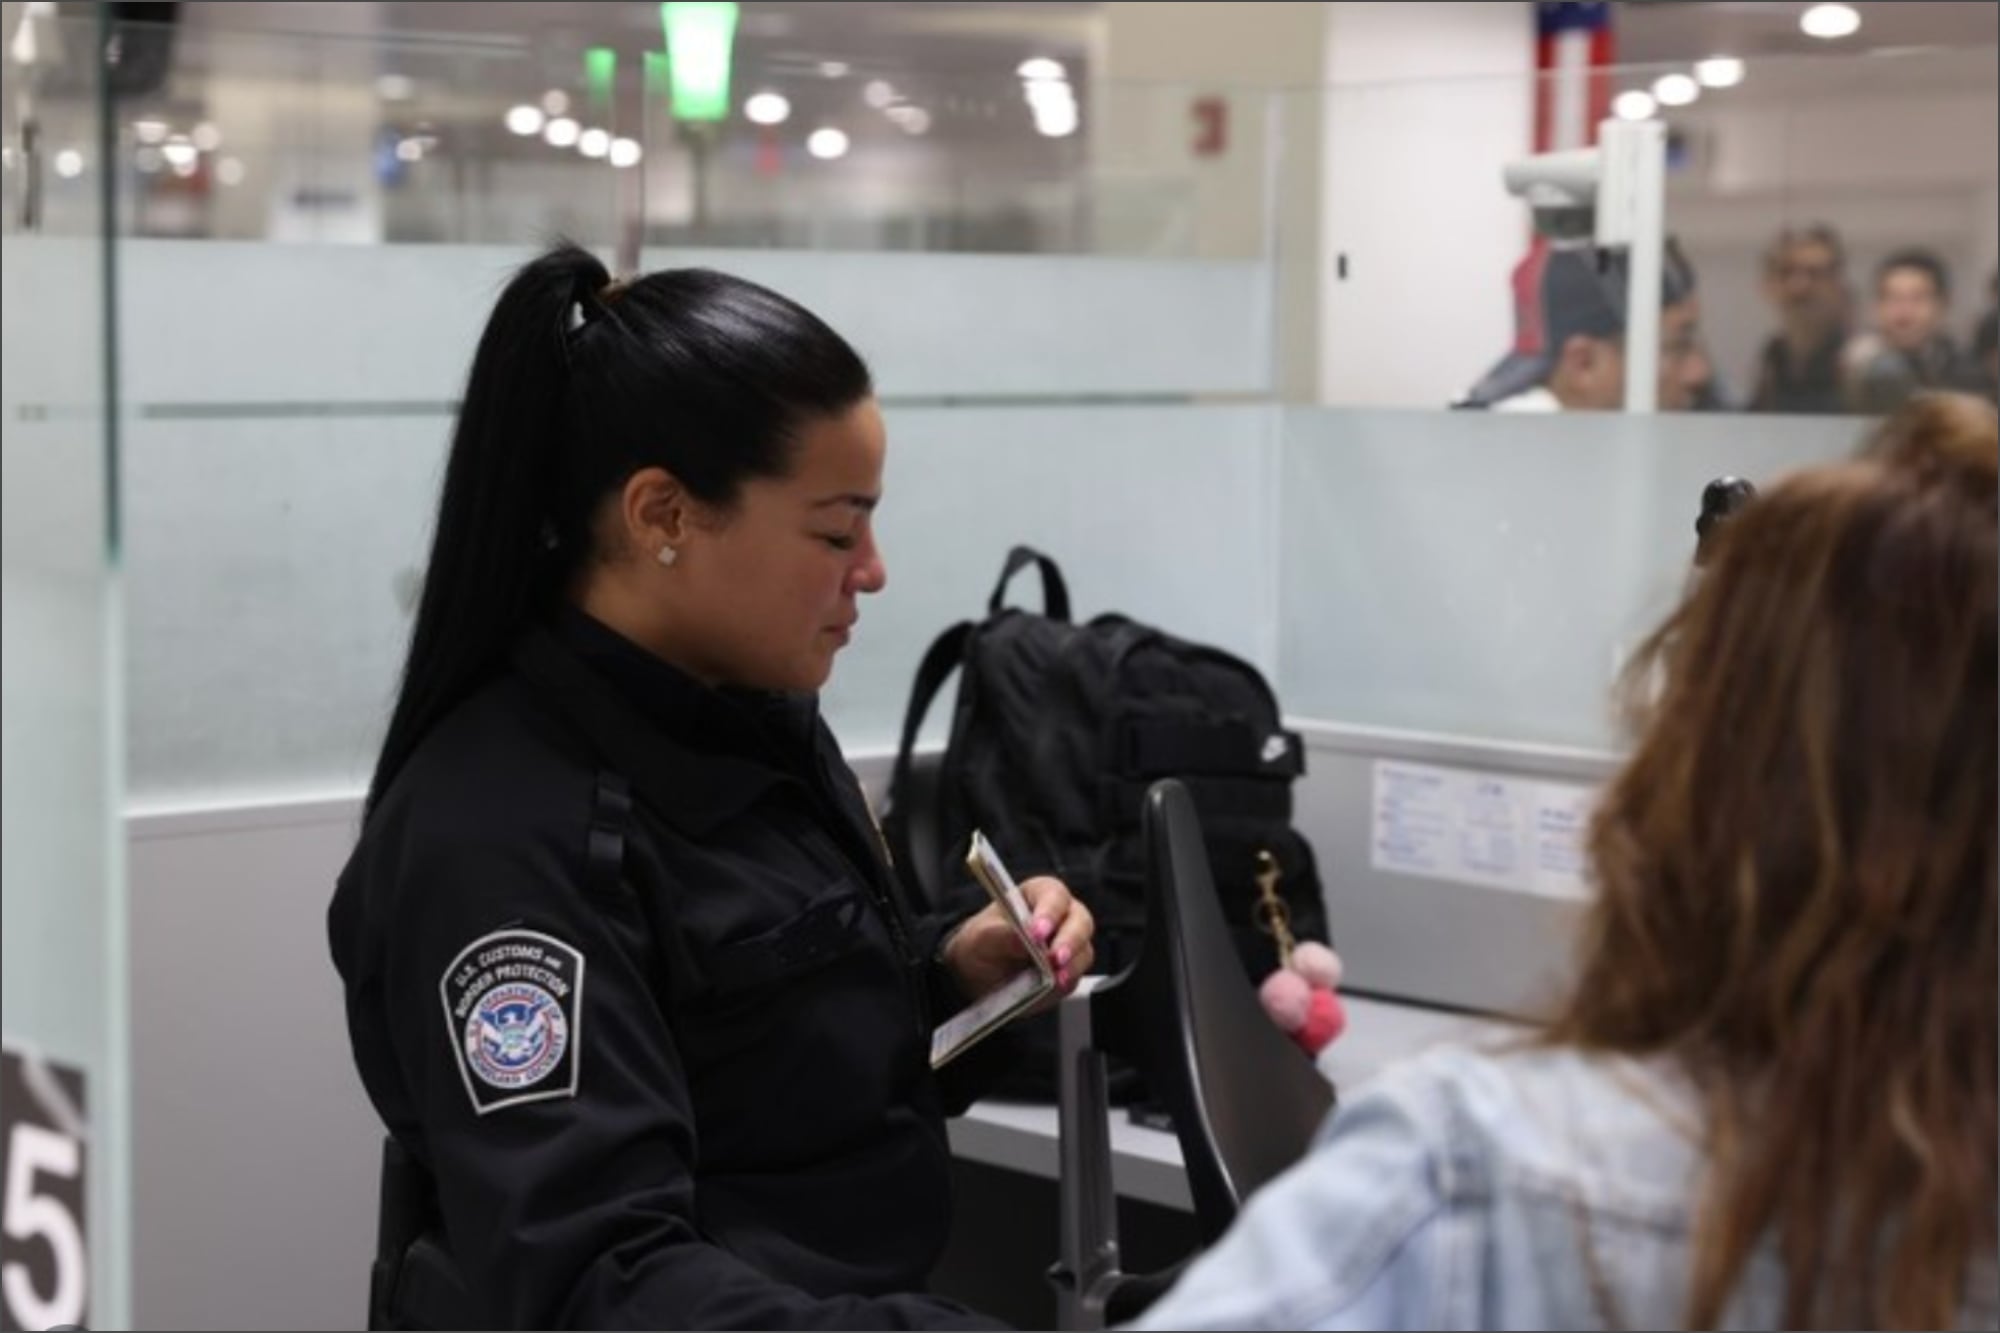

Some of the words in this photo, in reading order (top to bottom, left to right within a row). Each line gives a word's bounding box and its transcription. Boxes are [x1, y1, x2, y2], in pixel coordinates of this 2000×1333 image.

[479, 945, 544, 966] CUSTOMS
[455, 972, 494, 1017] BORDER
[495, 964, 570, 997] PROTECTION
[2, 1121, 84, 1332] 5
